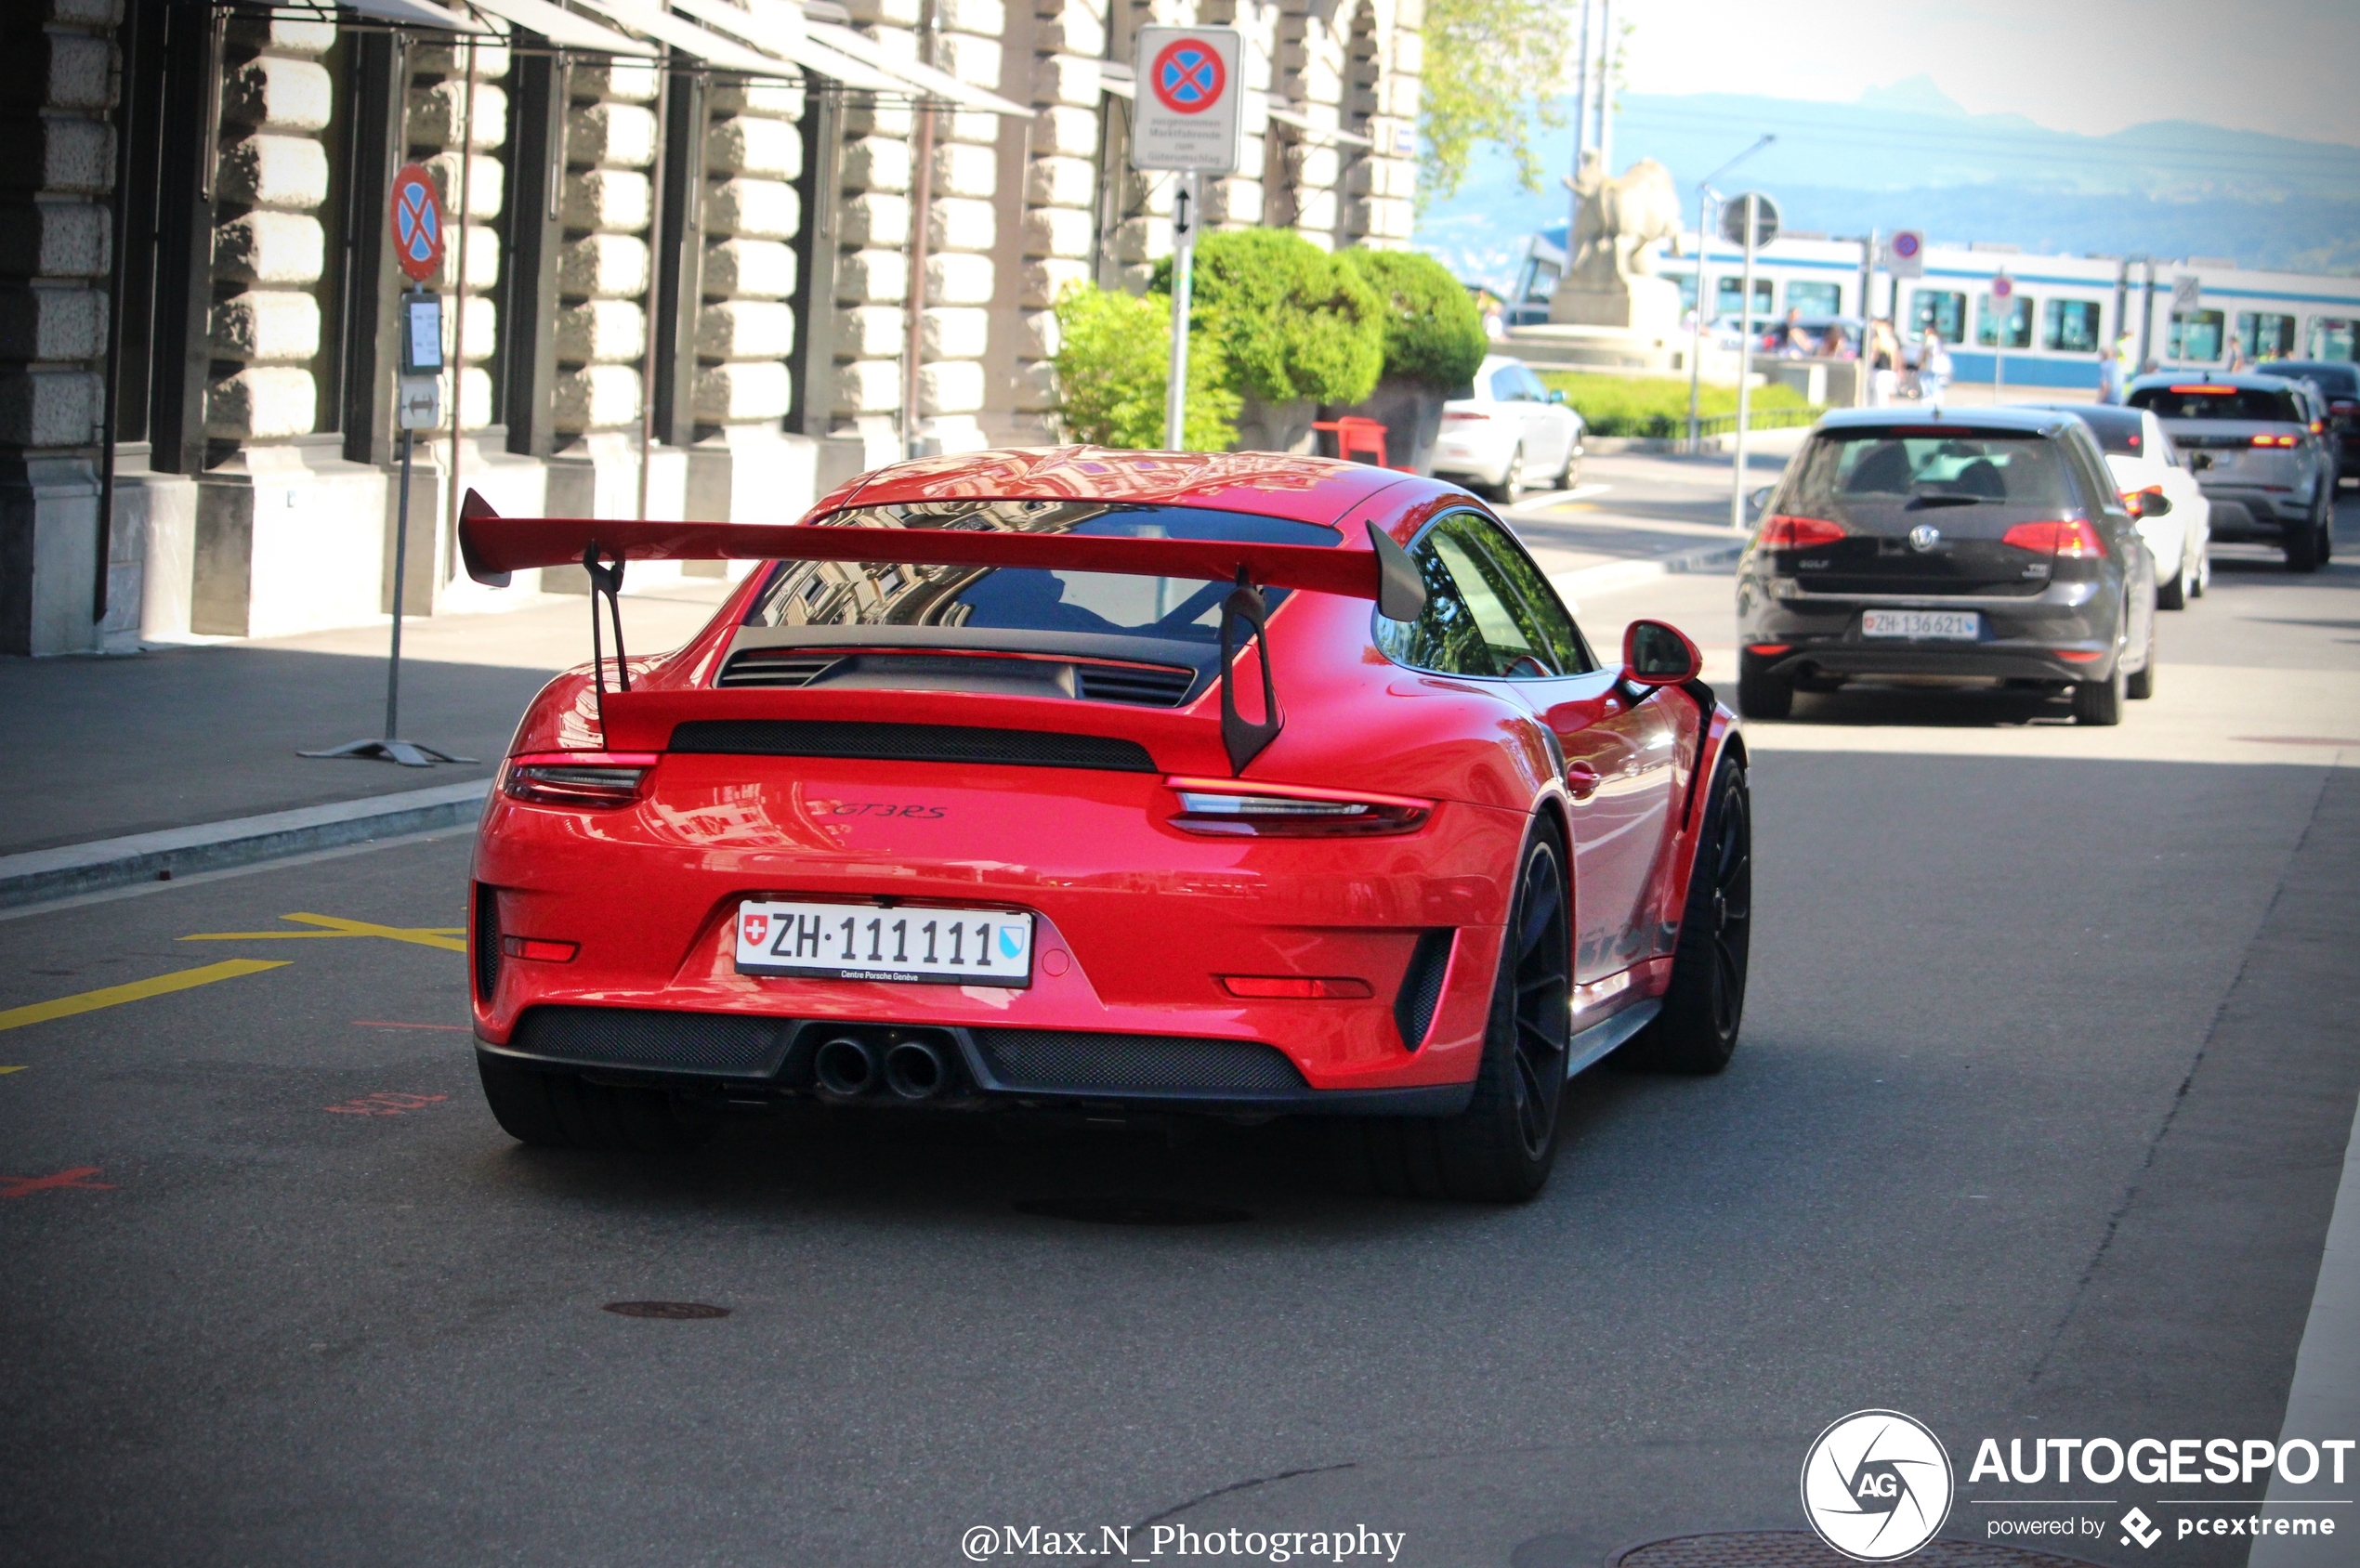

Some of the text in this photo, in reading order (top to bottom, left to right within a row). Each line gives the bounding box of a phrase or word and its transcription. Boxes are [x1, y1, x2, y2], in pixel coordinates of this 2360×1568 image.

[1151, 118, 1221, 127] ausgenommen
[1148, 128, 1221, 139] Marktfahrende
[841, 970, 919, 982] Centre Porsche Genève
